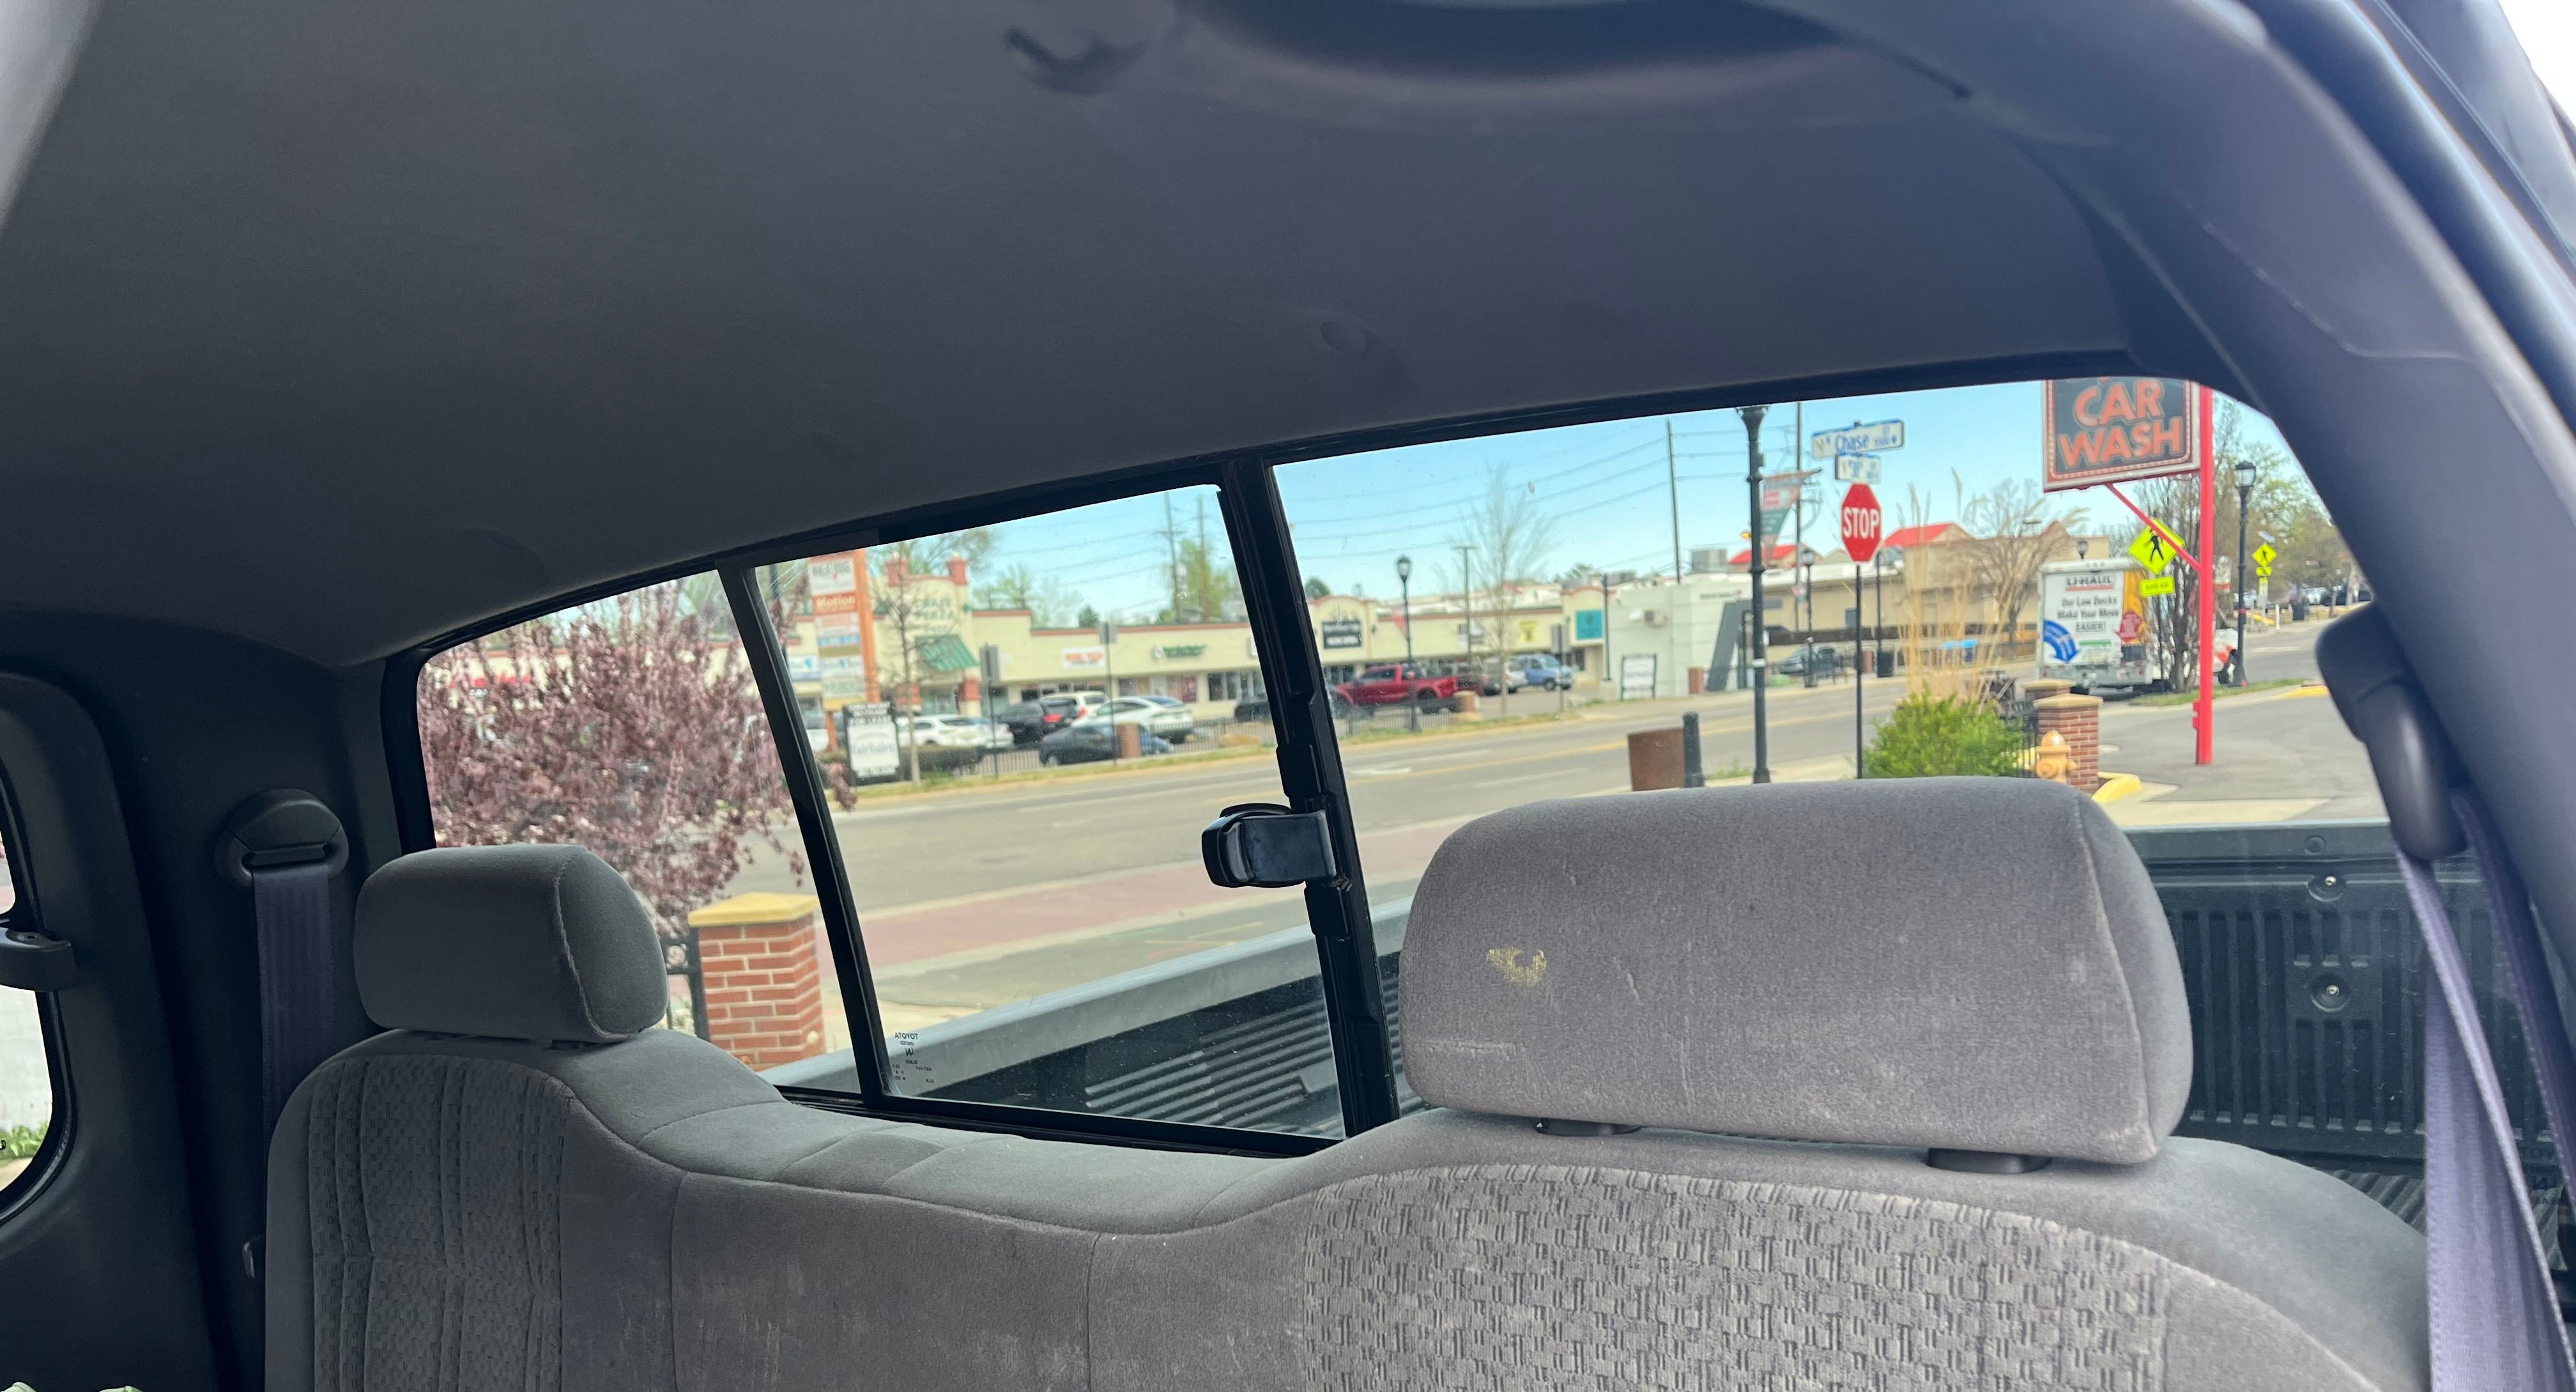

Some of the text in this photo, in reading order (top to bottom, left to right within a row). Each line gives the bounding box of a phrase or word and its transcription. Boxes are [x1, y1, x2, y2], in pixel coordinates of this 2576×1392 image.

[2075, 380, 2163, 428] CAR
[1835, 434, 1869, 452] Chase
[2058, 417, 2182, 468] WASH
[1842, 506, 1880, 539] STOP
[816, 596, 856, 608] Motion
